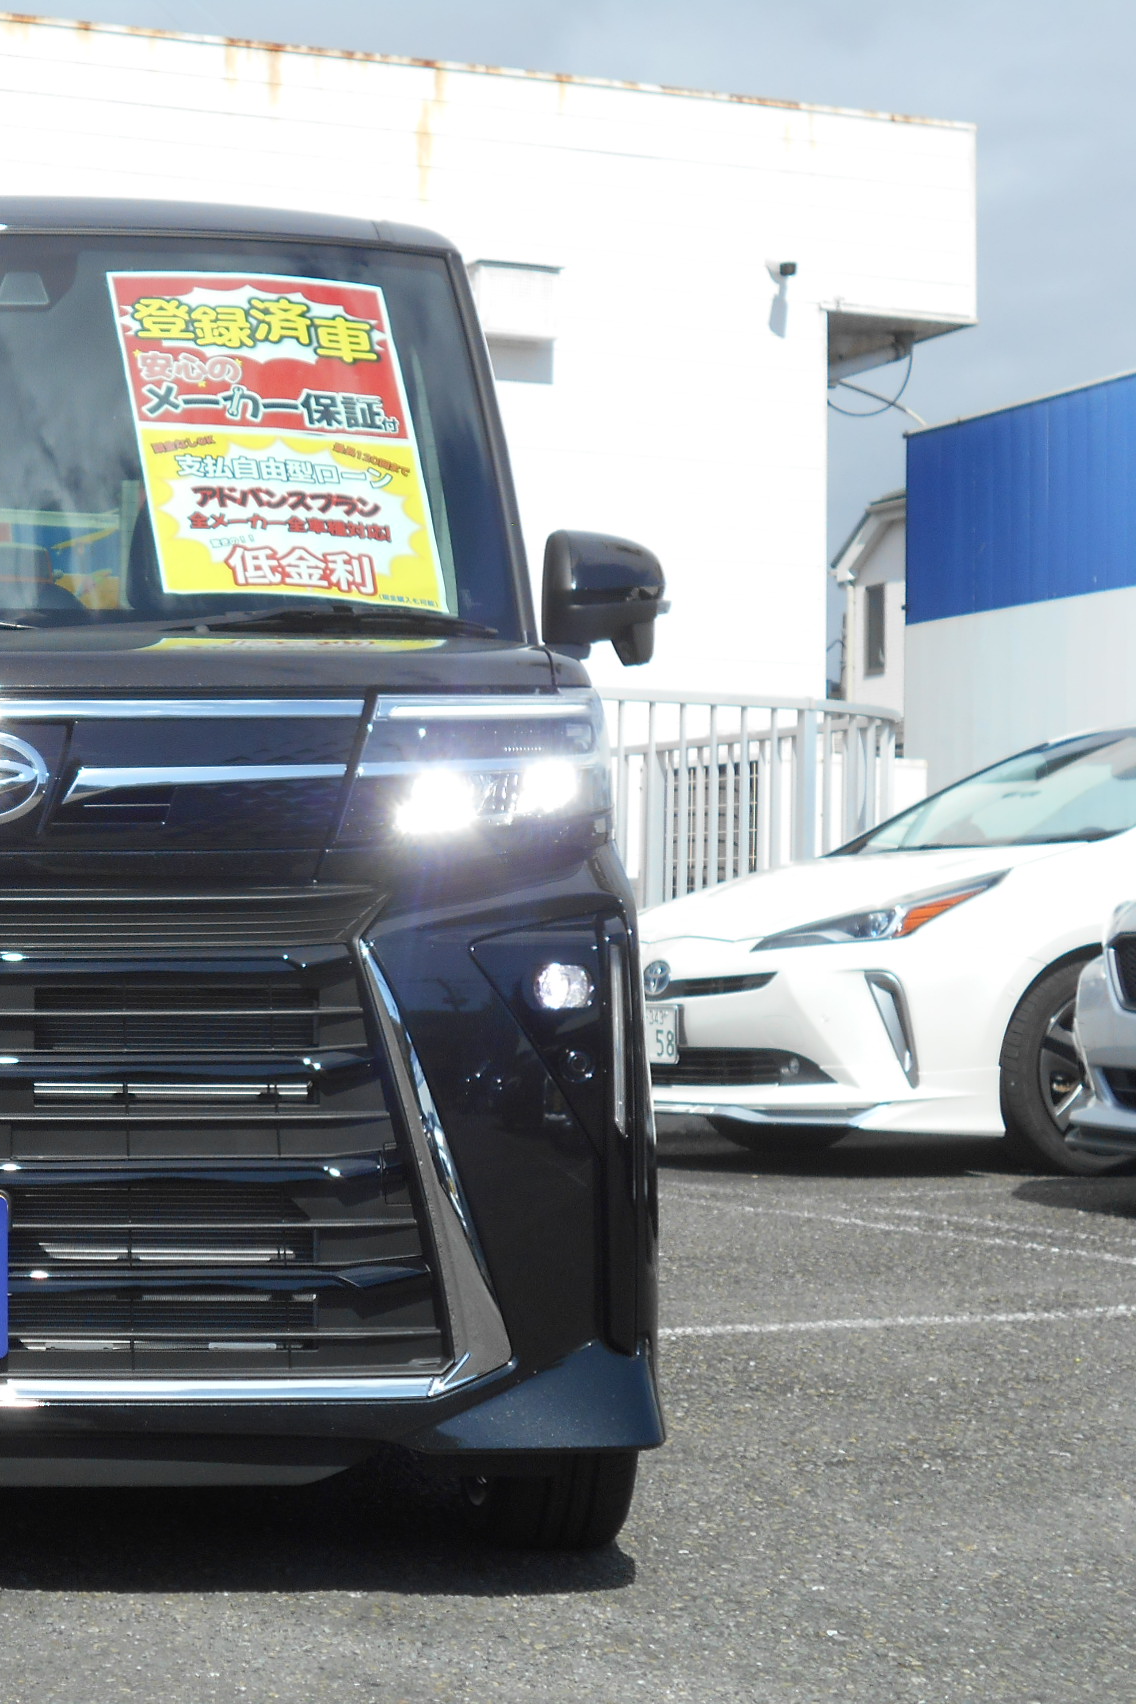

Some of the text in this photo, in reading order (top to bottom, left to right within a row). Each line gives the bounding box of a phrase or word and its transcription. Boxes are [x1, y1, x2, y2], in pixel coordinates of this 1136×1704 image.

[132, 296, 380, 364] 登録済車
[138, 351, 242, 384] 安心の
[141, 382, 398, 433] メーカー保証付
[175, 453, 393, 489] 支払自由型ローン
[192, 486, 381, 518] アドバンスプラン
[224, 545, 379, 595] 低金利
